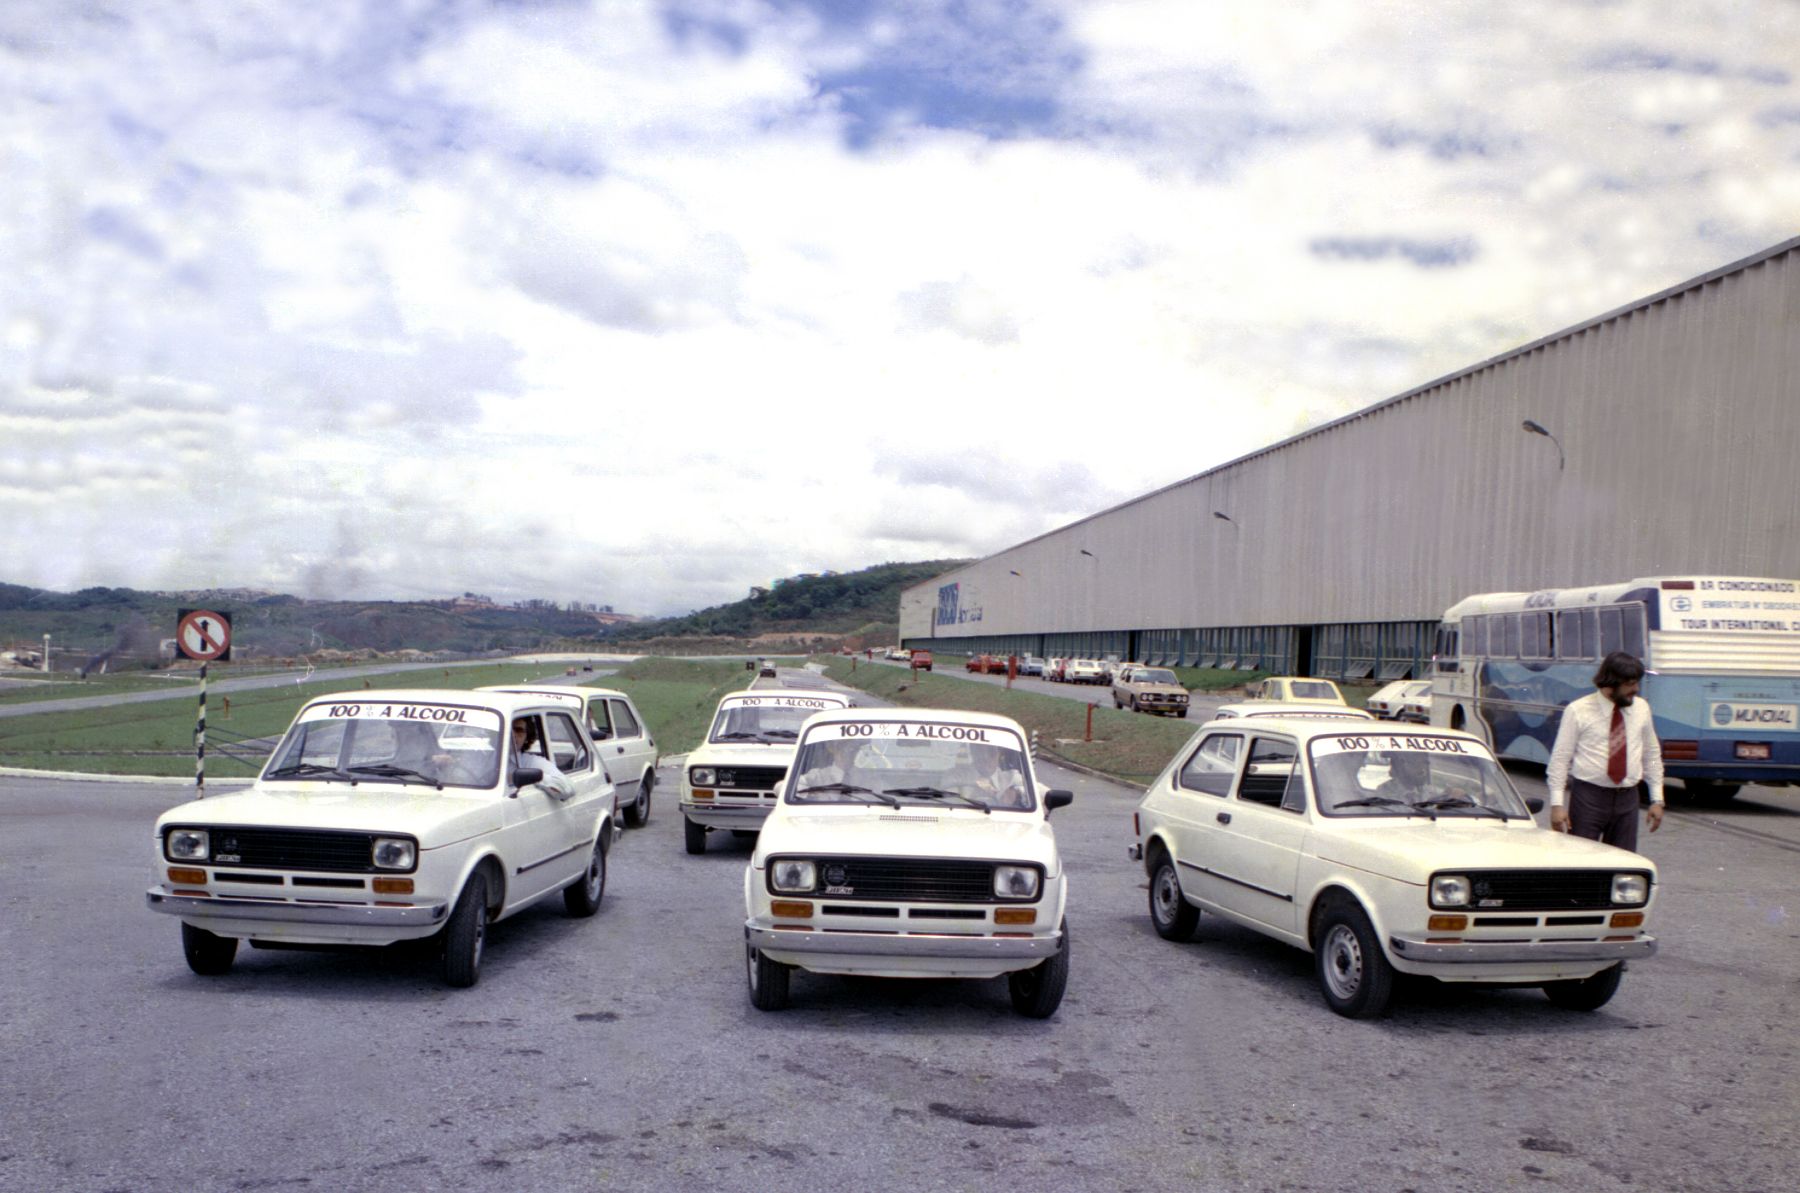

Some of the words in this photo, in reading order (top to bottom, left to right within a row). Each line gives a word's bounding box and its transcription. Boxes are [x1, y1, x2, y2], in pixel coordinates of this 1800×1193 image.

[1718, 581, 1795, 593] CONDICIONADO
[1681, 619, 1707, 629] TOUR
[1711, 619, 1789, 631] INTERNATIONAL
[742, 698, 761, 706] 100
[785, 699, 826, 709] ALCOOL
[328, 705, 361, 718] 100
[380, 706, 392, 718] A
[397, 706, 468, 723] ALCOOL
[840, 724, 873, 737] 100
[879, 724, 890, 736] %
[897, 725, 908, 737] A
[916, 725, 990, 743] ALCOOL
[1337, 737, 1369, 750] 100
[1390, 737, 1402, 749] A
[1406, 738, 1468, 754] ALCOOL
